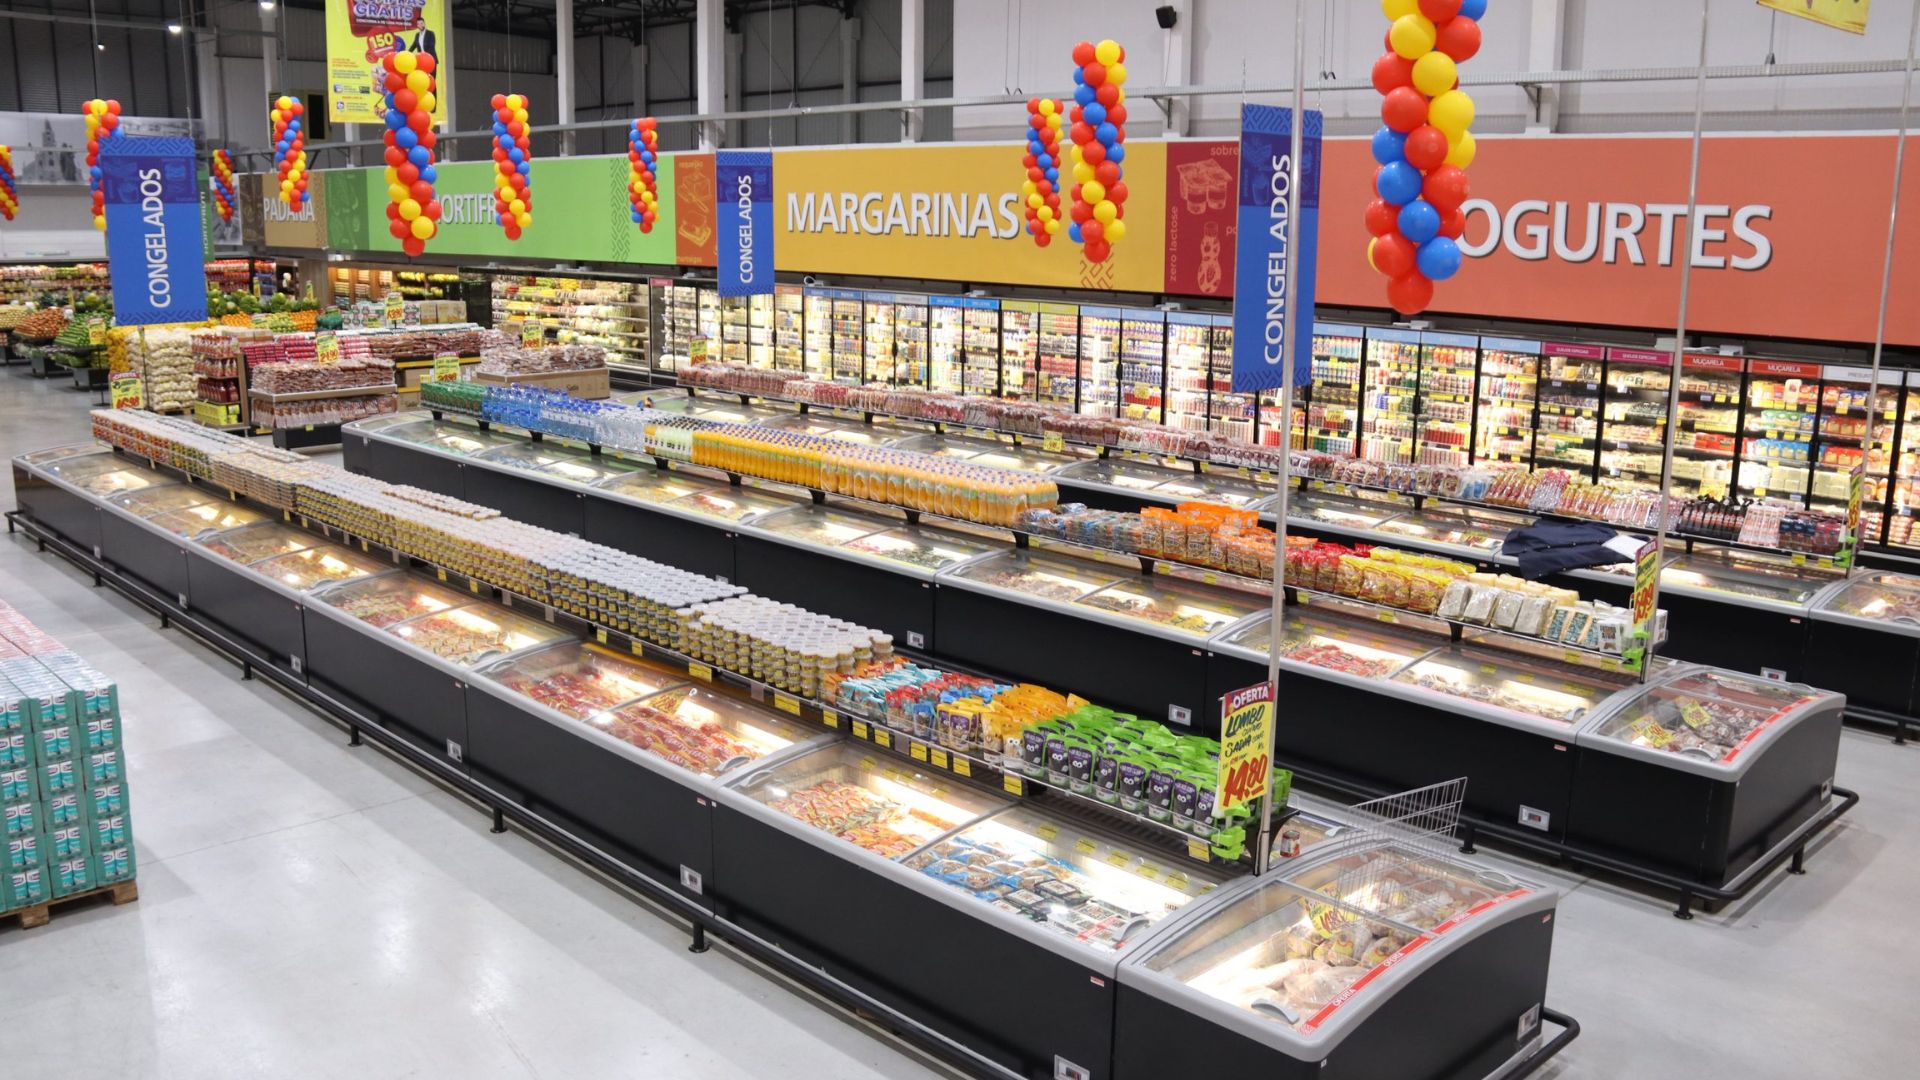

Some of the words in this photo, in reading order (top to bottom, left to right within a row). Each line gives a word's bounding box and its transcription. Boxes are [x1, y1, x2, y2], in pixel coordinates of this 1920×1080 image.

[354, 4, 413, 20] GRATIS
[369, 33, 394, 48] 150
[738, 175, 753, 283] CONGELADOS
[787, 191, 1022, 240] MARGARINAS
[1170, 206, 1178, 250] lactose
[1455, 198, 1773, 271] OGURTES
[139, 168, 171, 308] CONGELADOS
[1265, 154, 1290, 364] CONGELADOS
[1692, 358, 1724, 367] MUÇARELA
[1767, 363, 1801, 373] MUÇARELA
[1233, 686, 1269, 708] OFERTA
[1225, 704, 1265, 737] LOMBO
